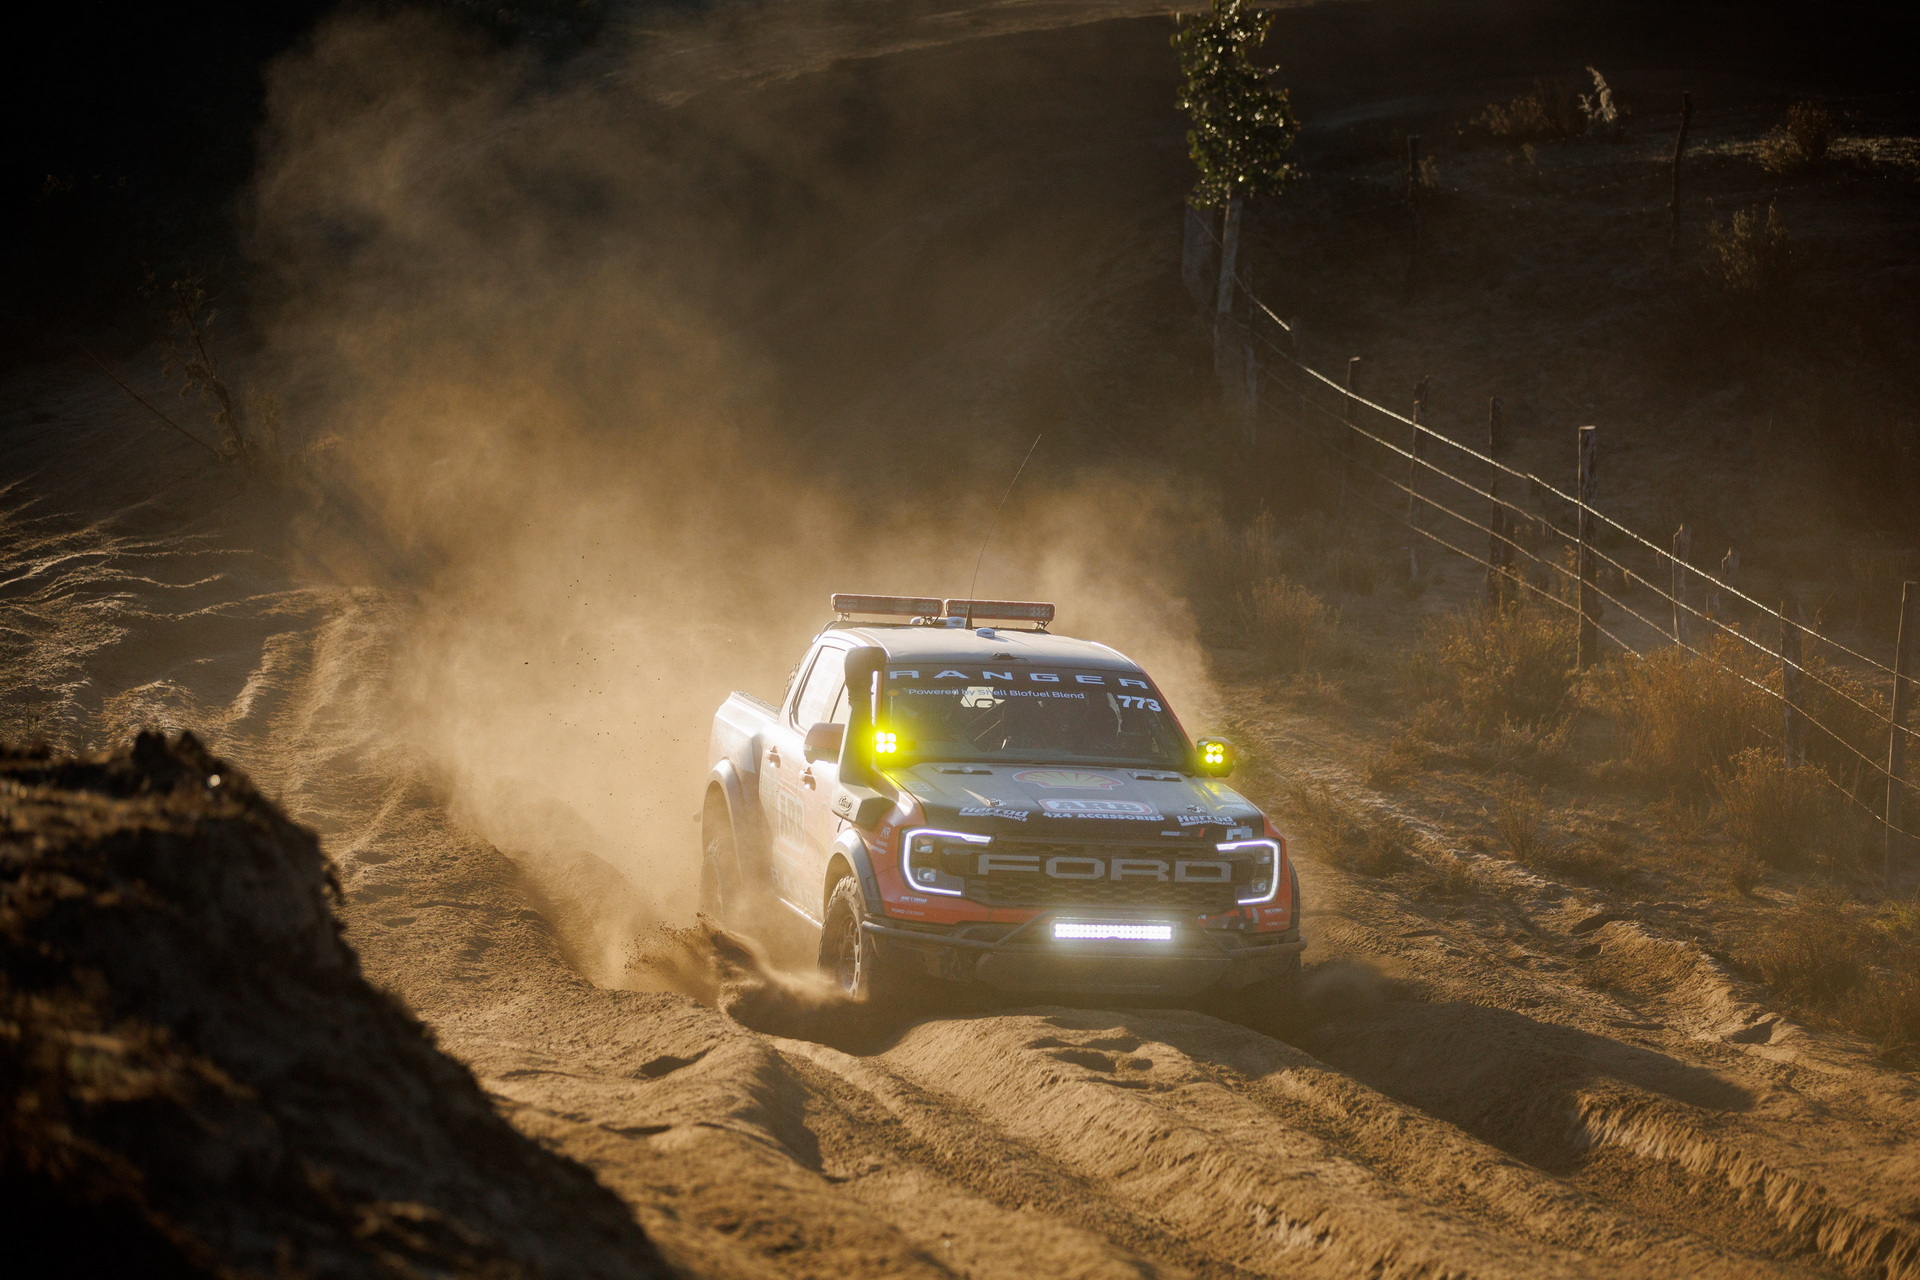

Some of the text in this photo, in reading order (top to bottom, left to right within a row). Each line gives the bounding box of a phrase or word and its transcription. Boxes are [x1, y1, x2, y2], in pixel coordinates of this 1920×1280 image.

[889, 670, 1149, 690] RANGER
[908, 688, 1085, 699] Powered by Shell Biofuel Blend
[1117, 695, 1162, 712] 773
[1055, 801, 1139, 812] ARB
[1077, 812, 1165, 821] ACCESSORIES
[977, 854, 1232, 883] FORD
